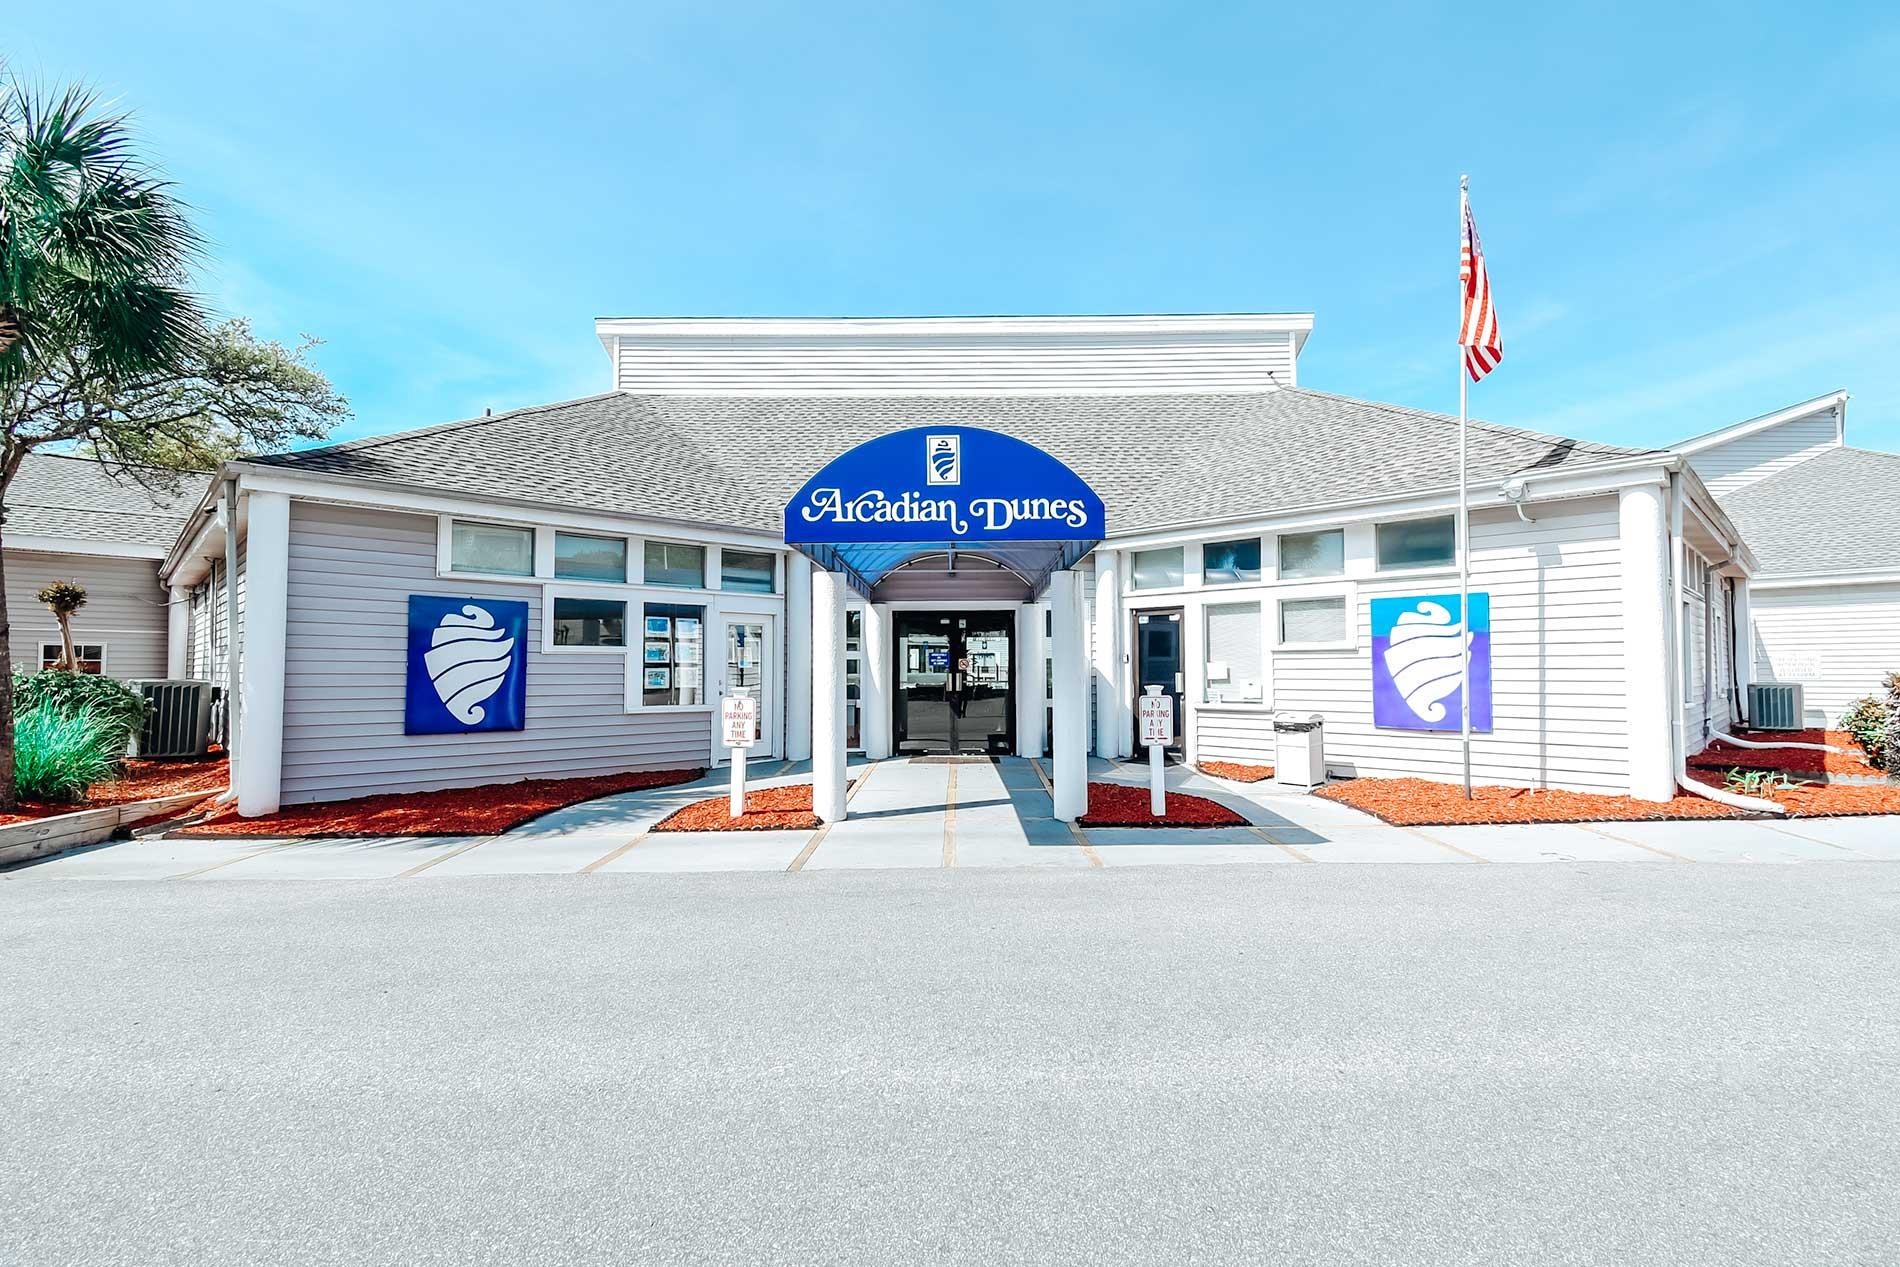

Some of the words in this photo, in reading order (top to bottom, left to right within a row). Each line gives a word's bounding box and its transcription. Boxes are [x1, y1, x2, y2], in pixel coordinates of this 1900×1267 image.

[801, 488, 968, 535] Arcadian
[969, 498, 1088, 531] Dunes
[734, 703, 744, 711] NO
[725, 711, 752, 720] PARKING
[731, 721, 745, 729] ANY
[1150, 719, 1162, 727] AY
[731, 730, 746, 739] TIME
